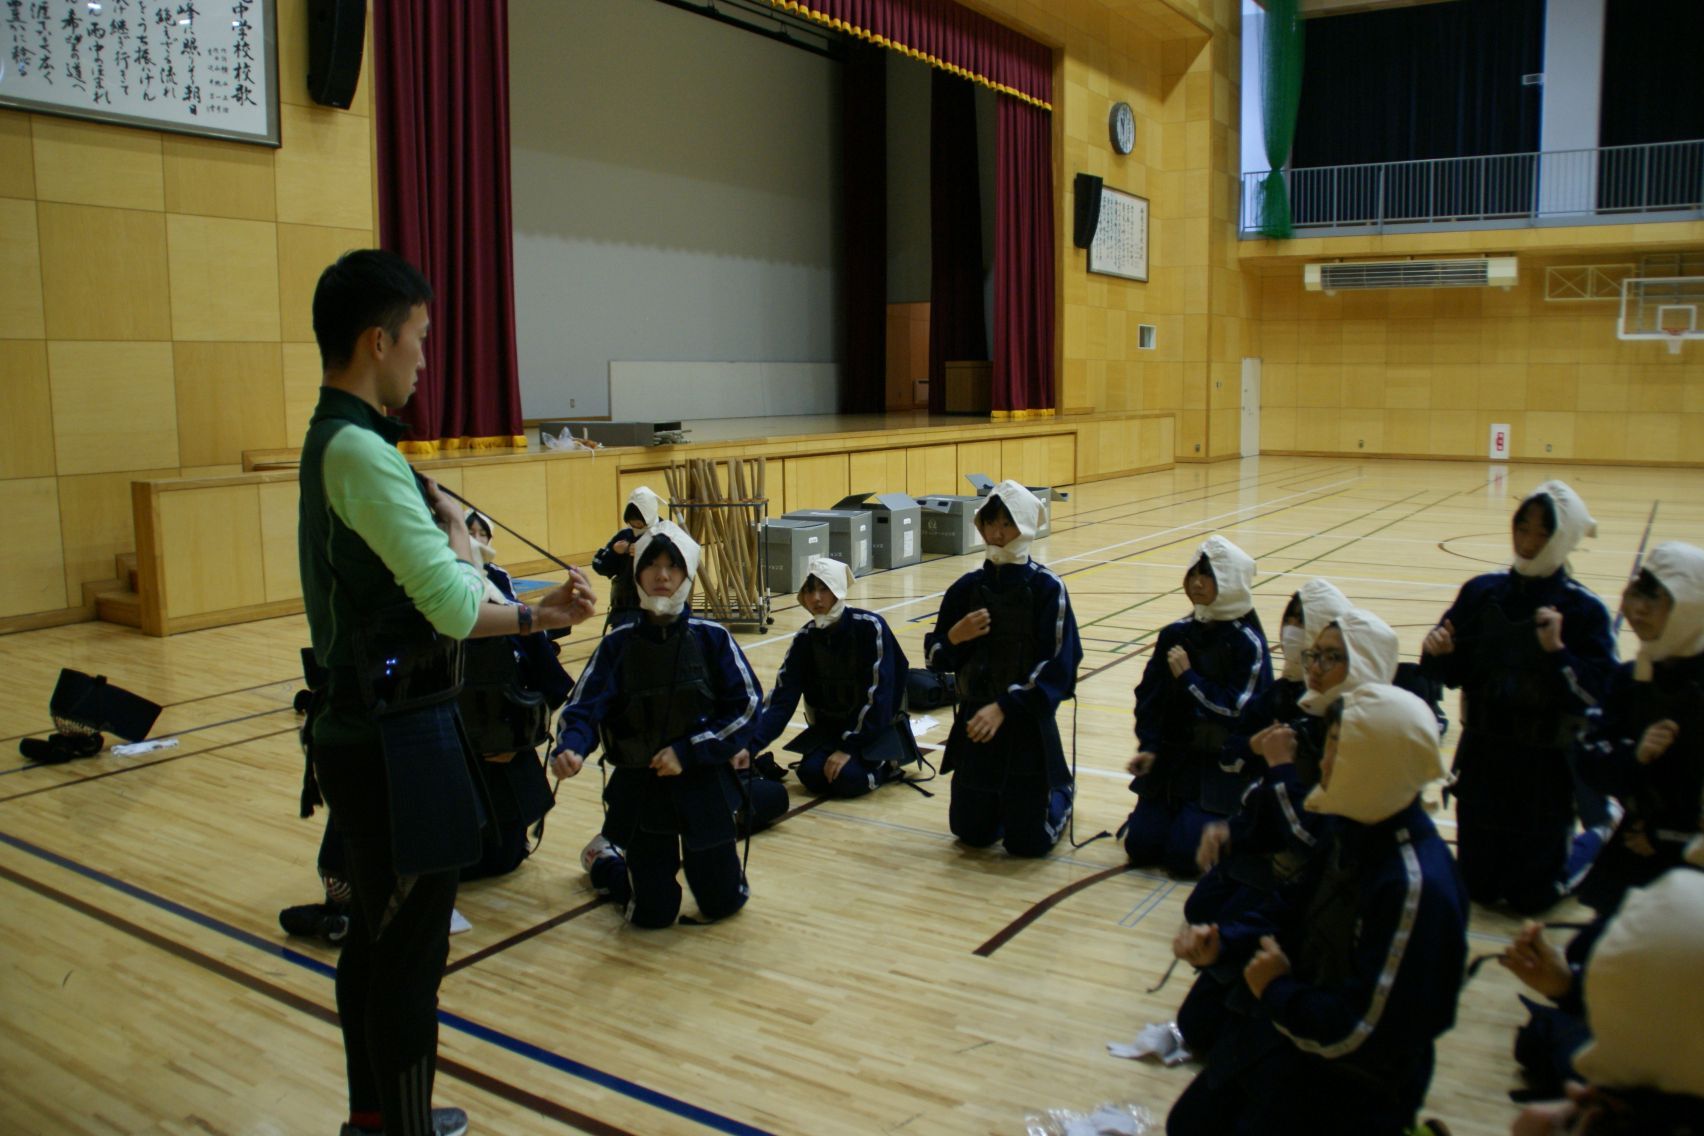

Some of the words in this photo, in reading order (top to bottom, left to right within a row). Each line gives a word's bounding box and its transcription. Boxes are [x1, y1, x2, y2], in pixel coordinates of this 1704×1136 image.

[231, 0, 257, 107] 中学校校歌
